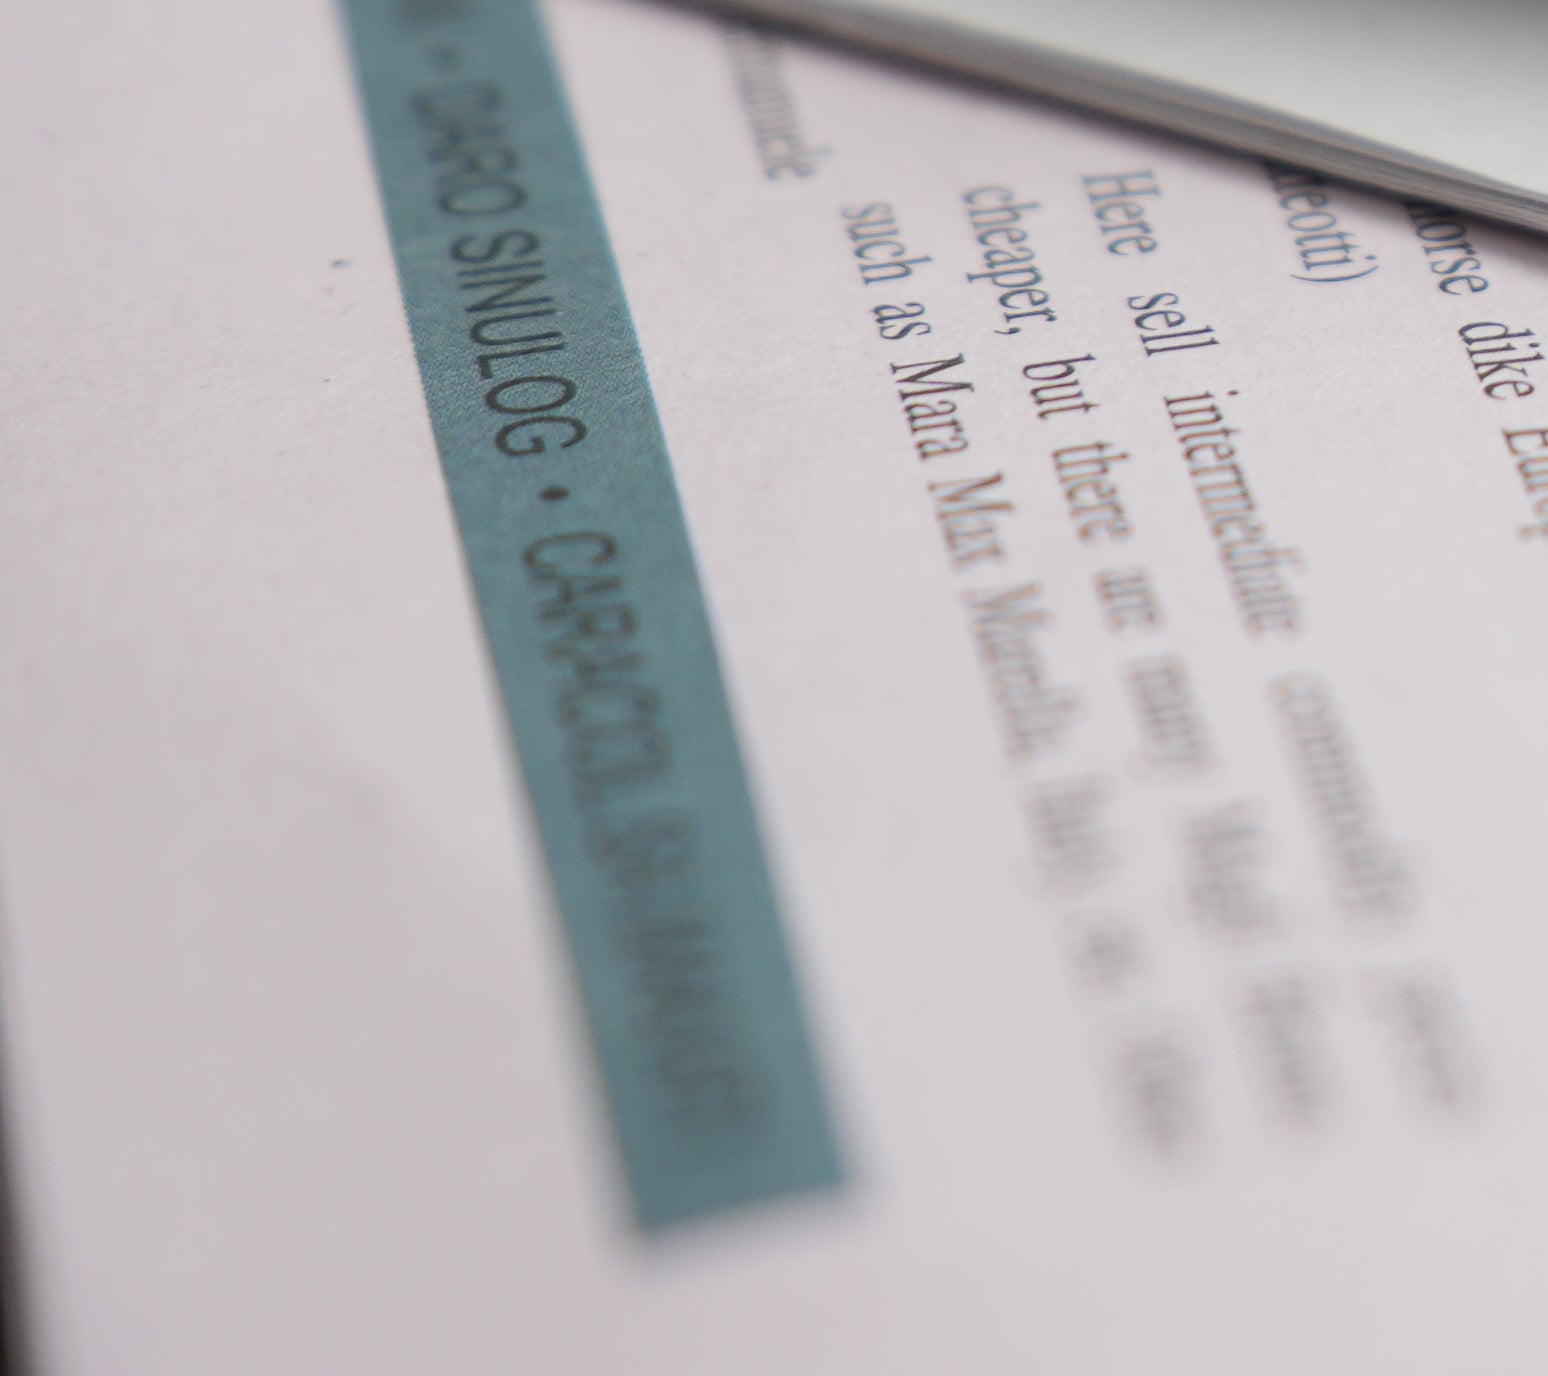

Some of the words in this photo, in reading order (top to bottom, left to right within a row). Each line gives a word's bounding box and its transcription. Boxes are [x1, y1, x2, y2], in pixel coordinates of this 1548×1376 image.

[842, 200, 932, 286] such
[961, 180, 1058, 338] cheaper,
[1082, 168, 1160, 258] Here
[447, 226, 588, 466] SINULOG
[874, 299, 932, 342] as
[1129, 286, 1220, 358] sell
[1458, 316, 1544, 402] dike
[891, 351, 975, 461] Mara
[1022, 353, 1099, 421] but
[929, 471, 1013, 572] Max
[1052, 439, 1132, 544] there
[1165, 388, 1308, 640] intermediate
